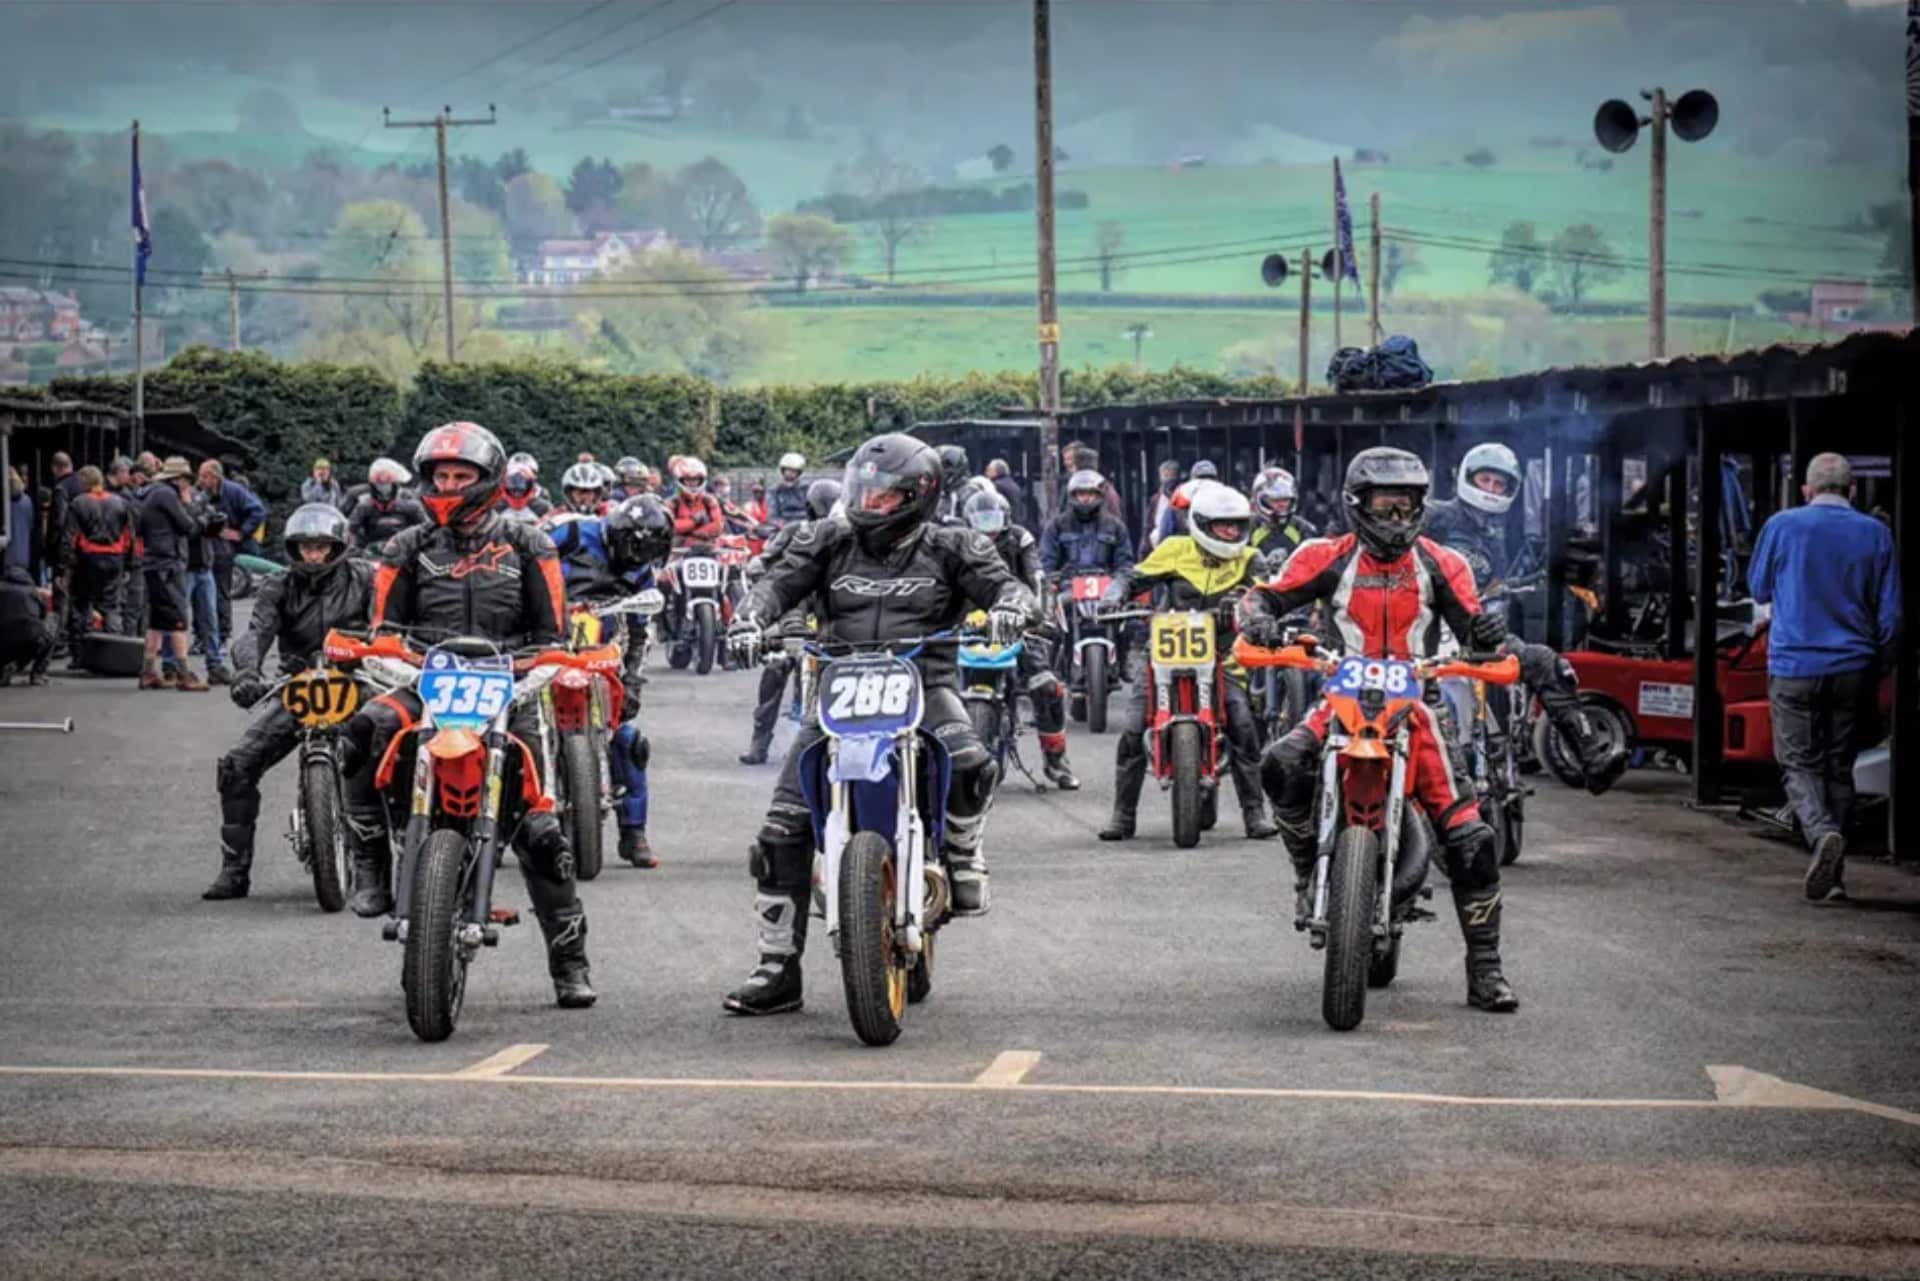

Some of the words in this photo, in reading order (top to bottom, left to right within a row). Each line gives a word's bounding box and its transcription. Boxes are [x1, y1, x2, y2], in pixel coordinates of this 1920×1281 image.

[687, 563, 716, 580] 891
[830, 575, 937, 597] RST
[1085, 576, 1098, 598] 3
[1158, 627, 1208, 658] 515
[1341, 660, 1408, 693] 398
[287, 678, 351, 718] 507
[428, 675, 509, 716] 335
[828, 673, 911, 720] 288
